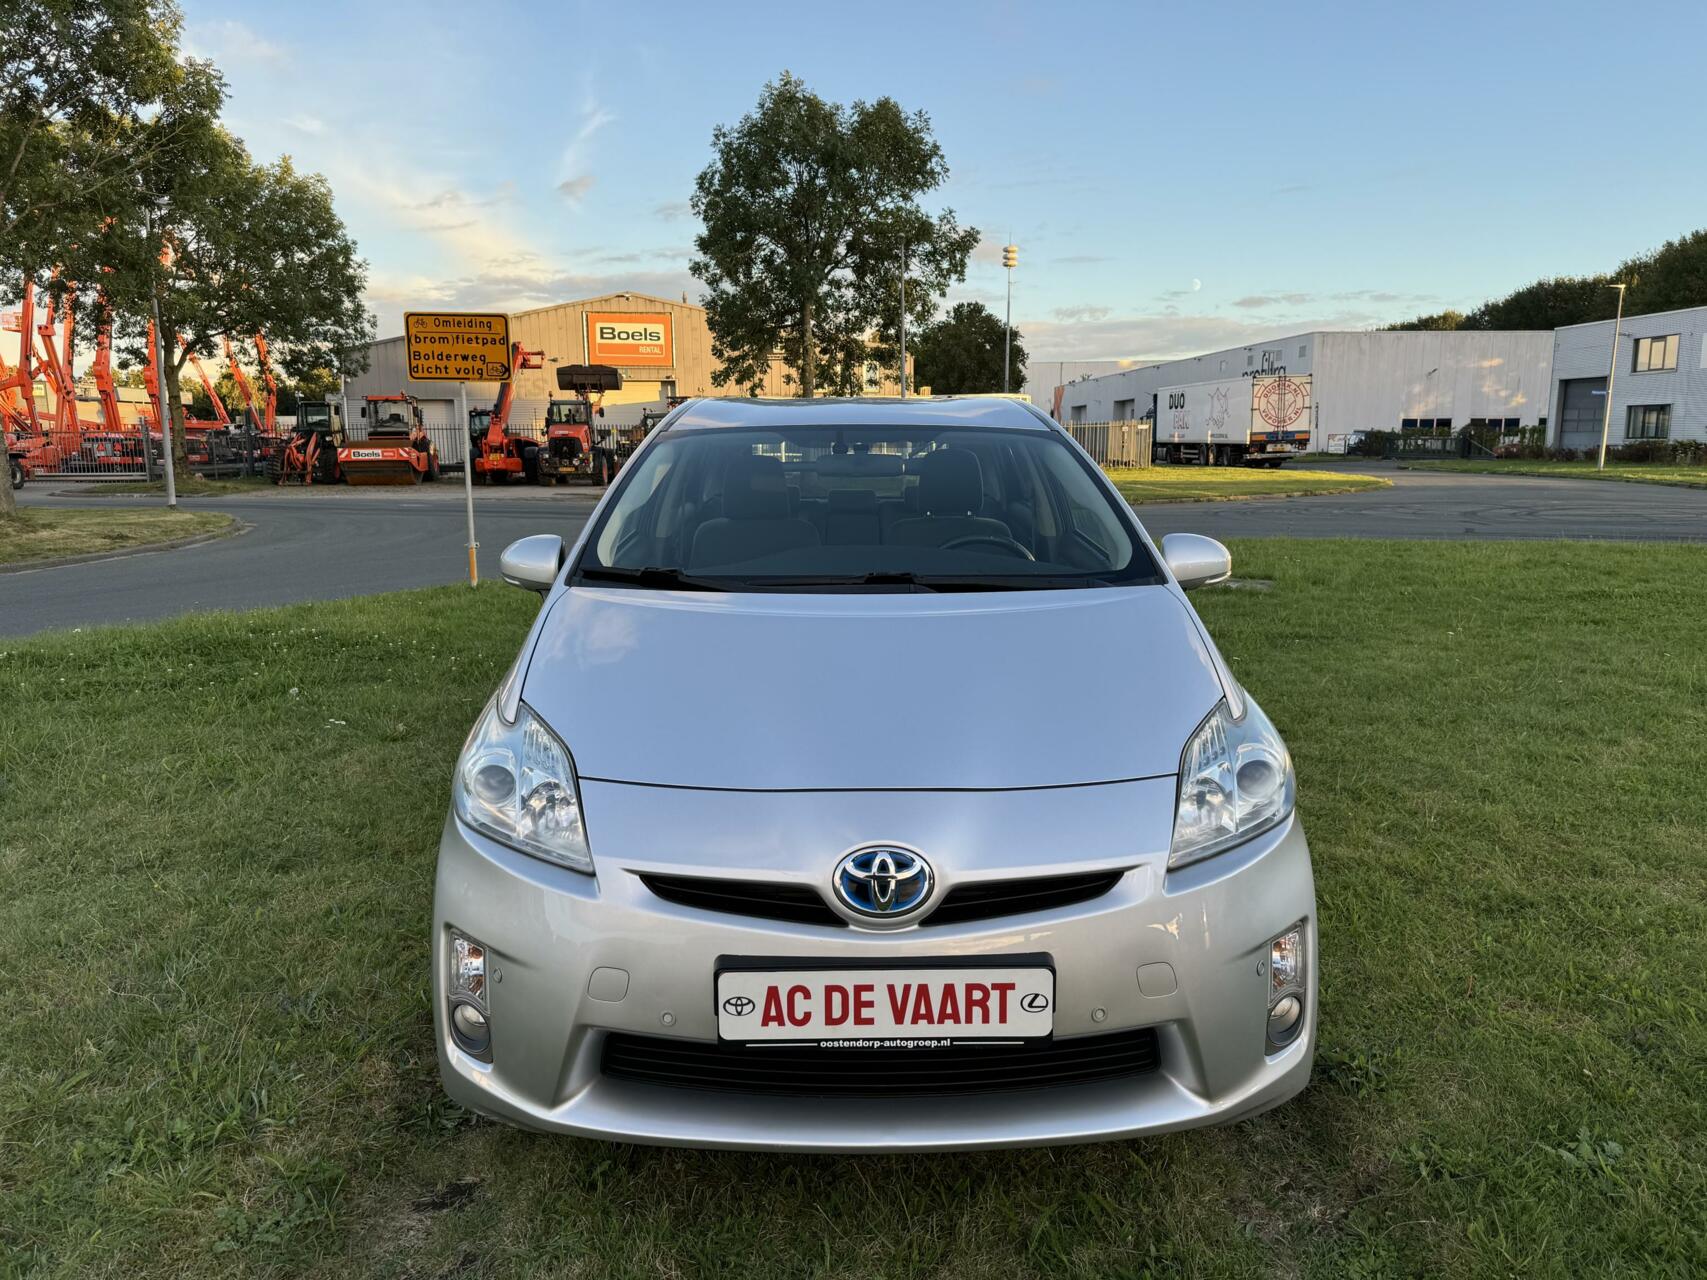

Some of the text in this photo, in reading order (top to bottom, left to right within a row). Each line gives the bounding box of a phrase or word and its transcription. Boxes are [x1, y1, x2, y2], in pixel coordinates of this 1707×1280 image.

[433, 317, 492, 331] Omleiding
[409, 334, 506, 346] (brom)fietpad
[599, 326, 661, 342] Boels
[639, 345, 662, 354] RENTAL
[413, 350, 486, 365] Bolderweg
[412, 364, 485, 378] dicht volg
[1168, 392, 1185, 410] DUO
[352, 450, 381, 458] Boels
[760, 982, 1016, 1027] AC DE VAART
[819, 1038, 951, 1049] oostendorp-autogroep.nl
